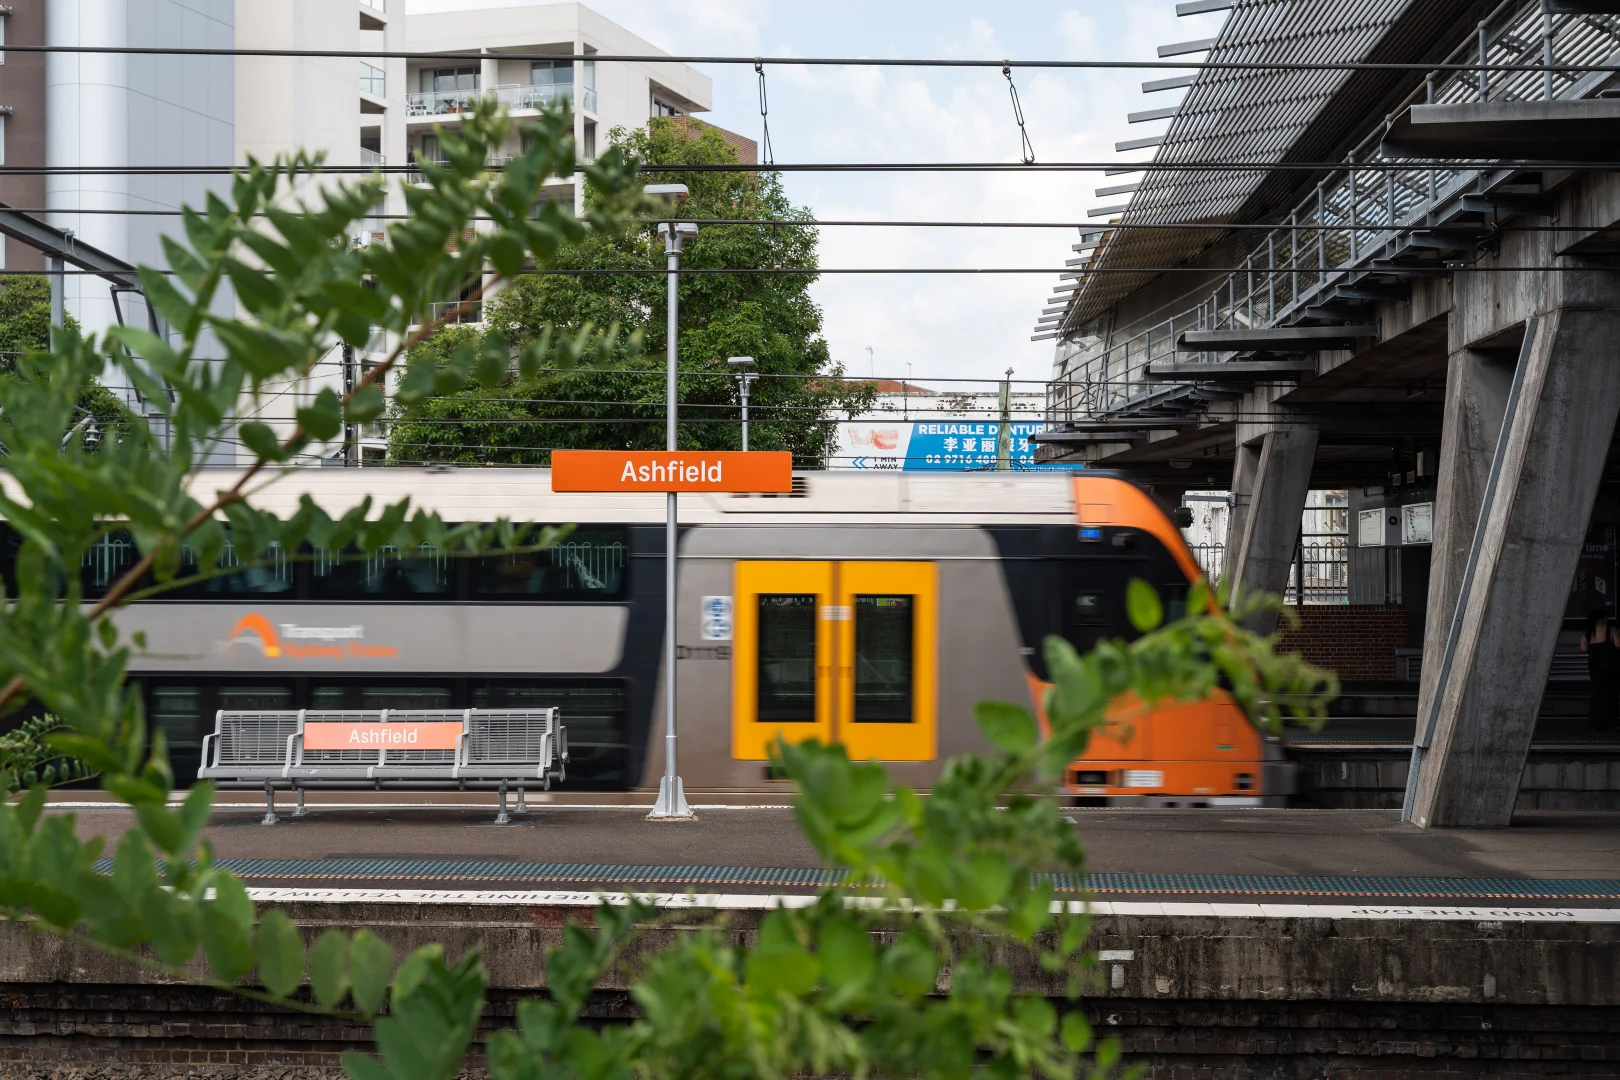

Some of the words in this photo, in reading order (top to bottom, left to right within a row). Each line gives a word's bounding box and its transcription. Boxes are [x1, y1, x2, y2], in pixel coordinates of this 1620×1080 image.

[919, 425, 984, 435] RELIABLE
[988, 425, 1043, 435] DNTUR
[943, 437, 1039, 453] 李亚丽牙
[925, 454, 941, 464] 02
[944, 454, 973, 464] 9716
[975, 454, 997, 465] 488
[1019, 455, 1035, 465] 04
[620, 460, 722, 482] Ashfield
[349, 729, 418, 744] Ashfield
